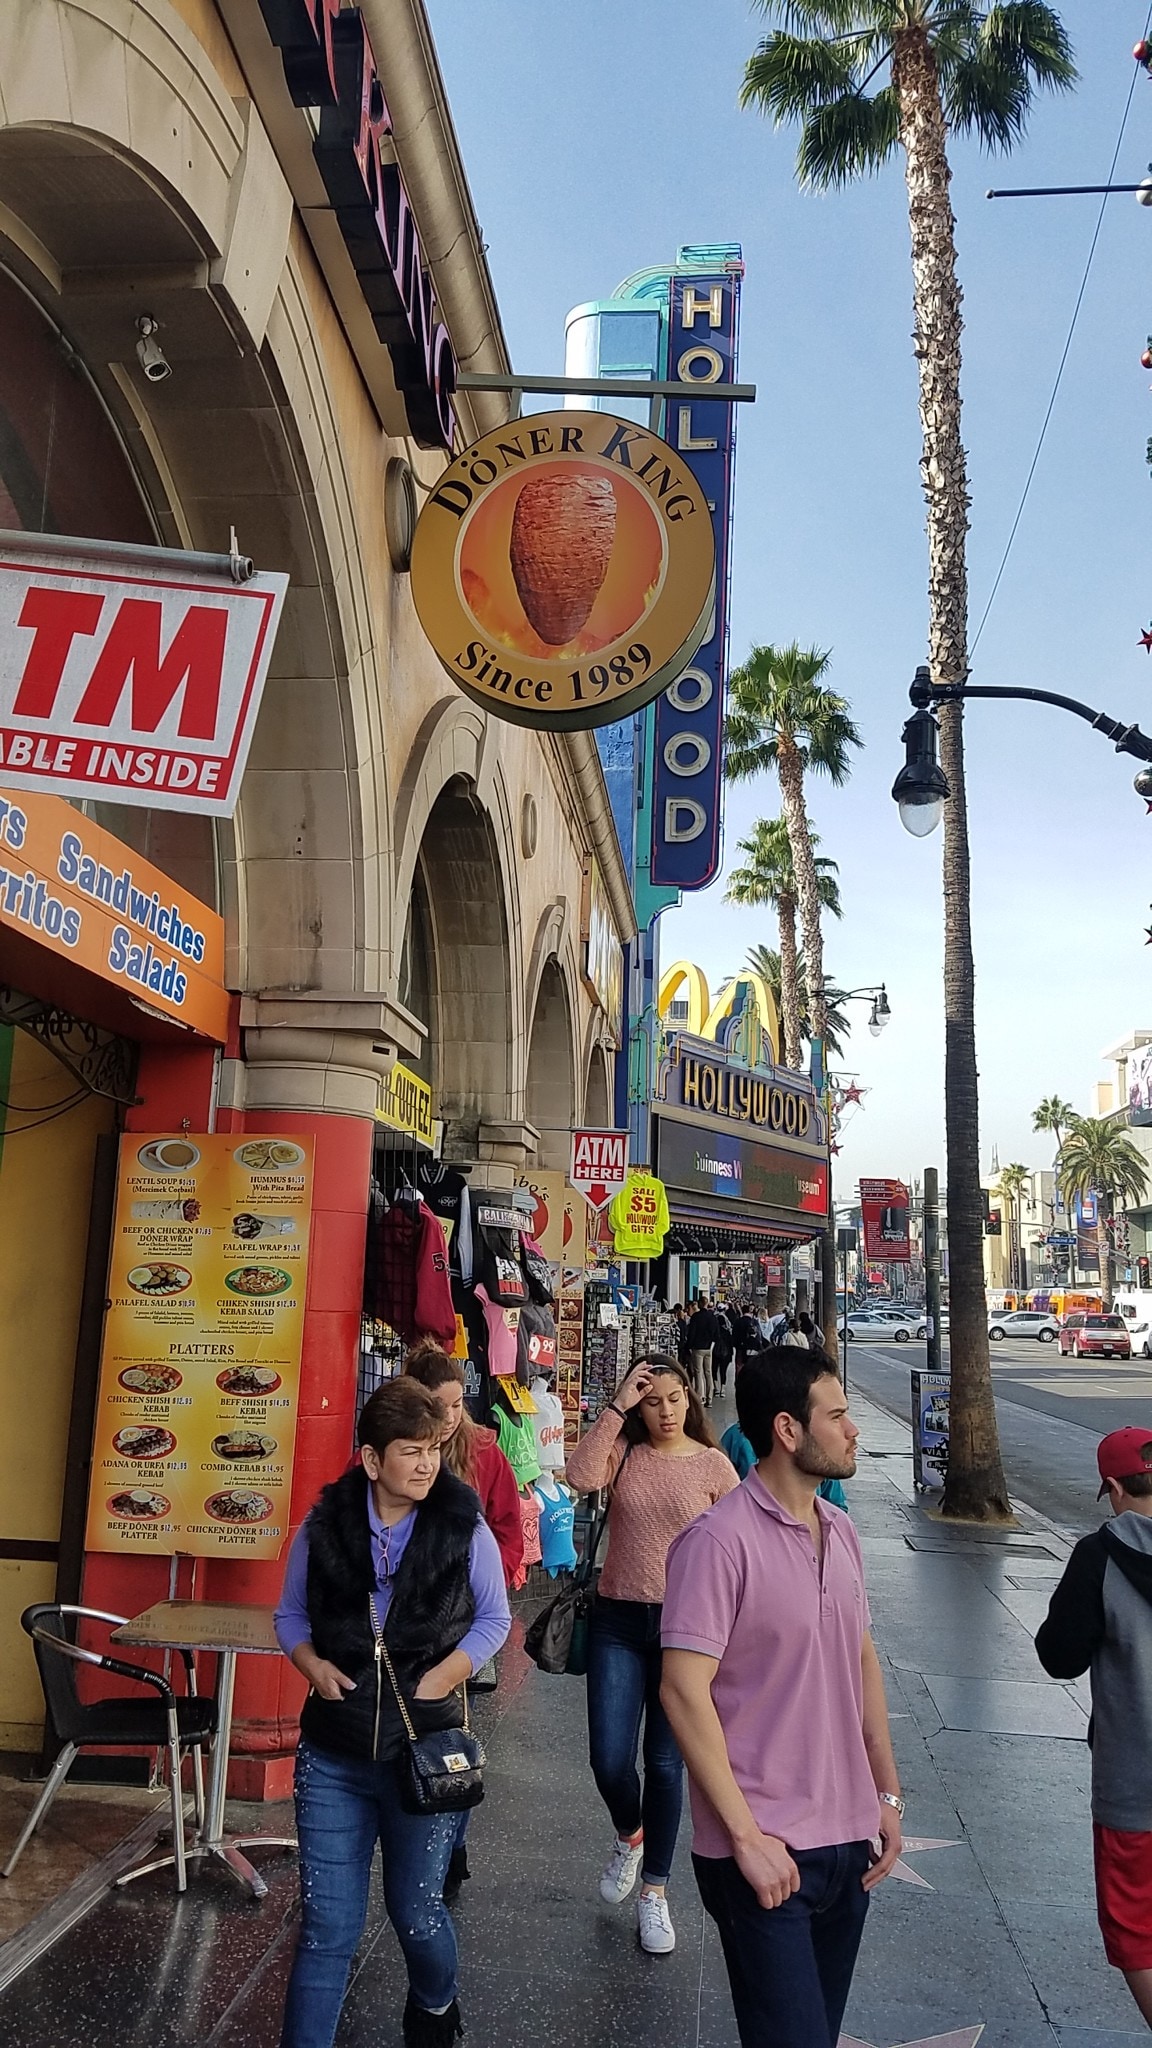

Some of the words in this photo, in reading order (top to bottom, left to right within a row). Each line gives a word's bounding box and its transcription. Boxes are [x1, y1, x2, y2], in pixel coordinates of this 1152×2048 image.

[429, 426, 585, 520] DÖNER
[598, 423, 697, 523] KING
[664, 285, 724, 843] HOLOOD
[453, 641, 553, 702] Since
[567, 643, 652, 702] 1989
[0, 733, 77, 773] BLE
[86, 746, 222, 793] INSIDE
[58, 832, 206, 963] Sandwiches
[109, 925, 187, 1005] Salads
[683, 1058, 810, 1137] HOLLYWOOD
[575, 1136, 623, 1167] ATM
[693, 1151, 732, 1178] Guinness
[575, 1166, 622, 1180] HERE
[631, 1195, 656, 1212] $5
[122, 1226, 143, 1234] BEEF
[139, 1234, 168, 1242] DÖNER
[150, 1299, 177, 1307] SALAD
[169, 1344, 235, 1355] PLATTERS
[529, 1336, 541, 1360] 9
[542, 1341, 554, 1353] 99
[107, 1395, 144, 1404] CHICKEN
[101, 1460, 129, 1468] ADANA
[200, 1463, 232, 1471] COMBO
[129, 1522, 158, 1531] DÖNER
[186, 1525, 225, 1534] CHICKEN
[226, 1526, 257, 1535] DÖNER
[121, 1531, 158, 1539] PLATTER
[218, 1536, 256, 1544] PLATTER
